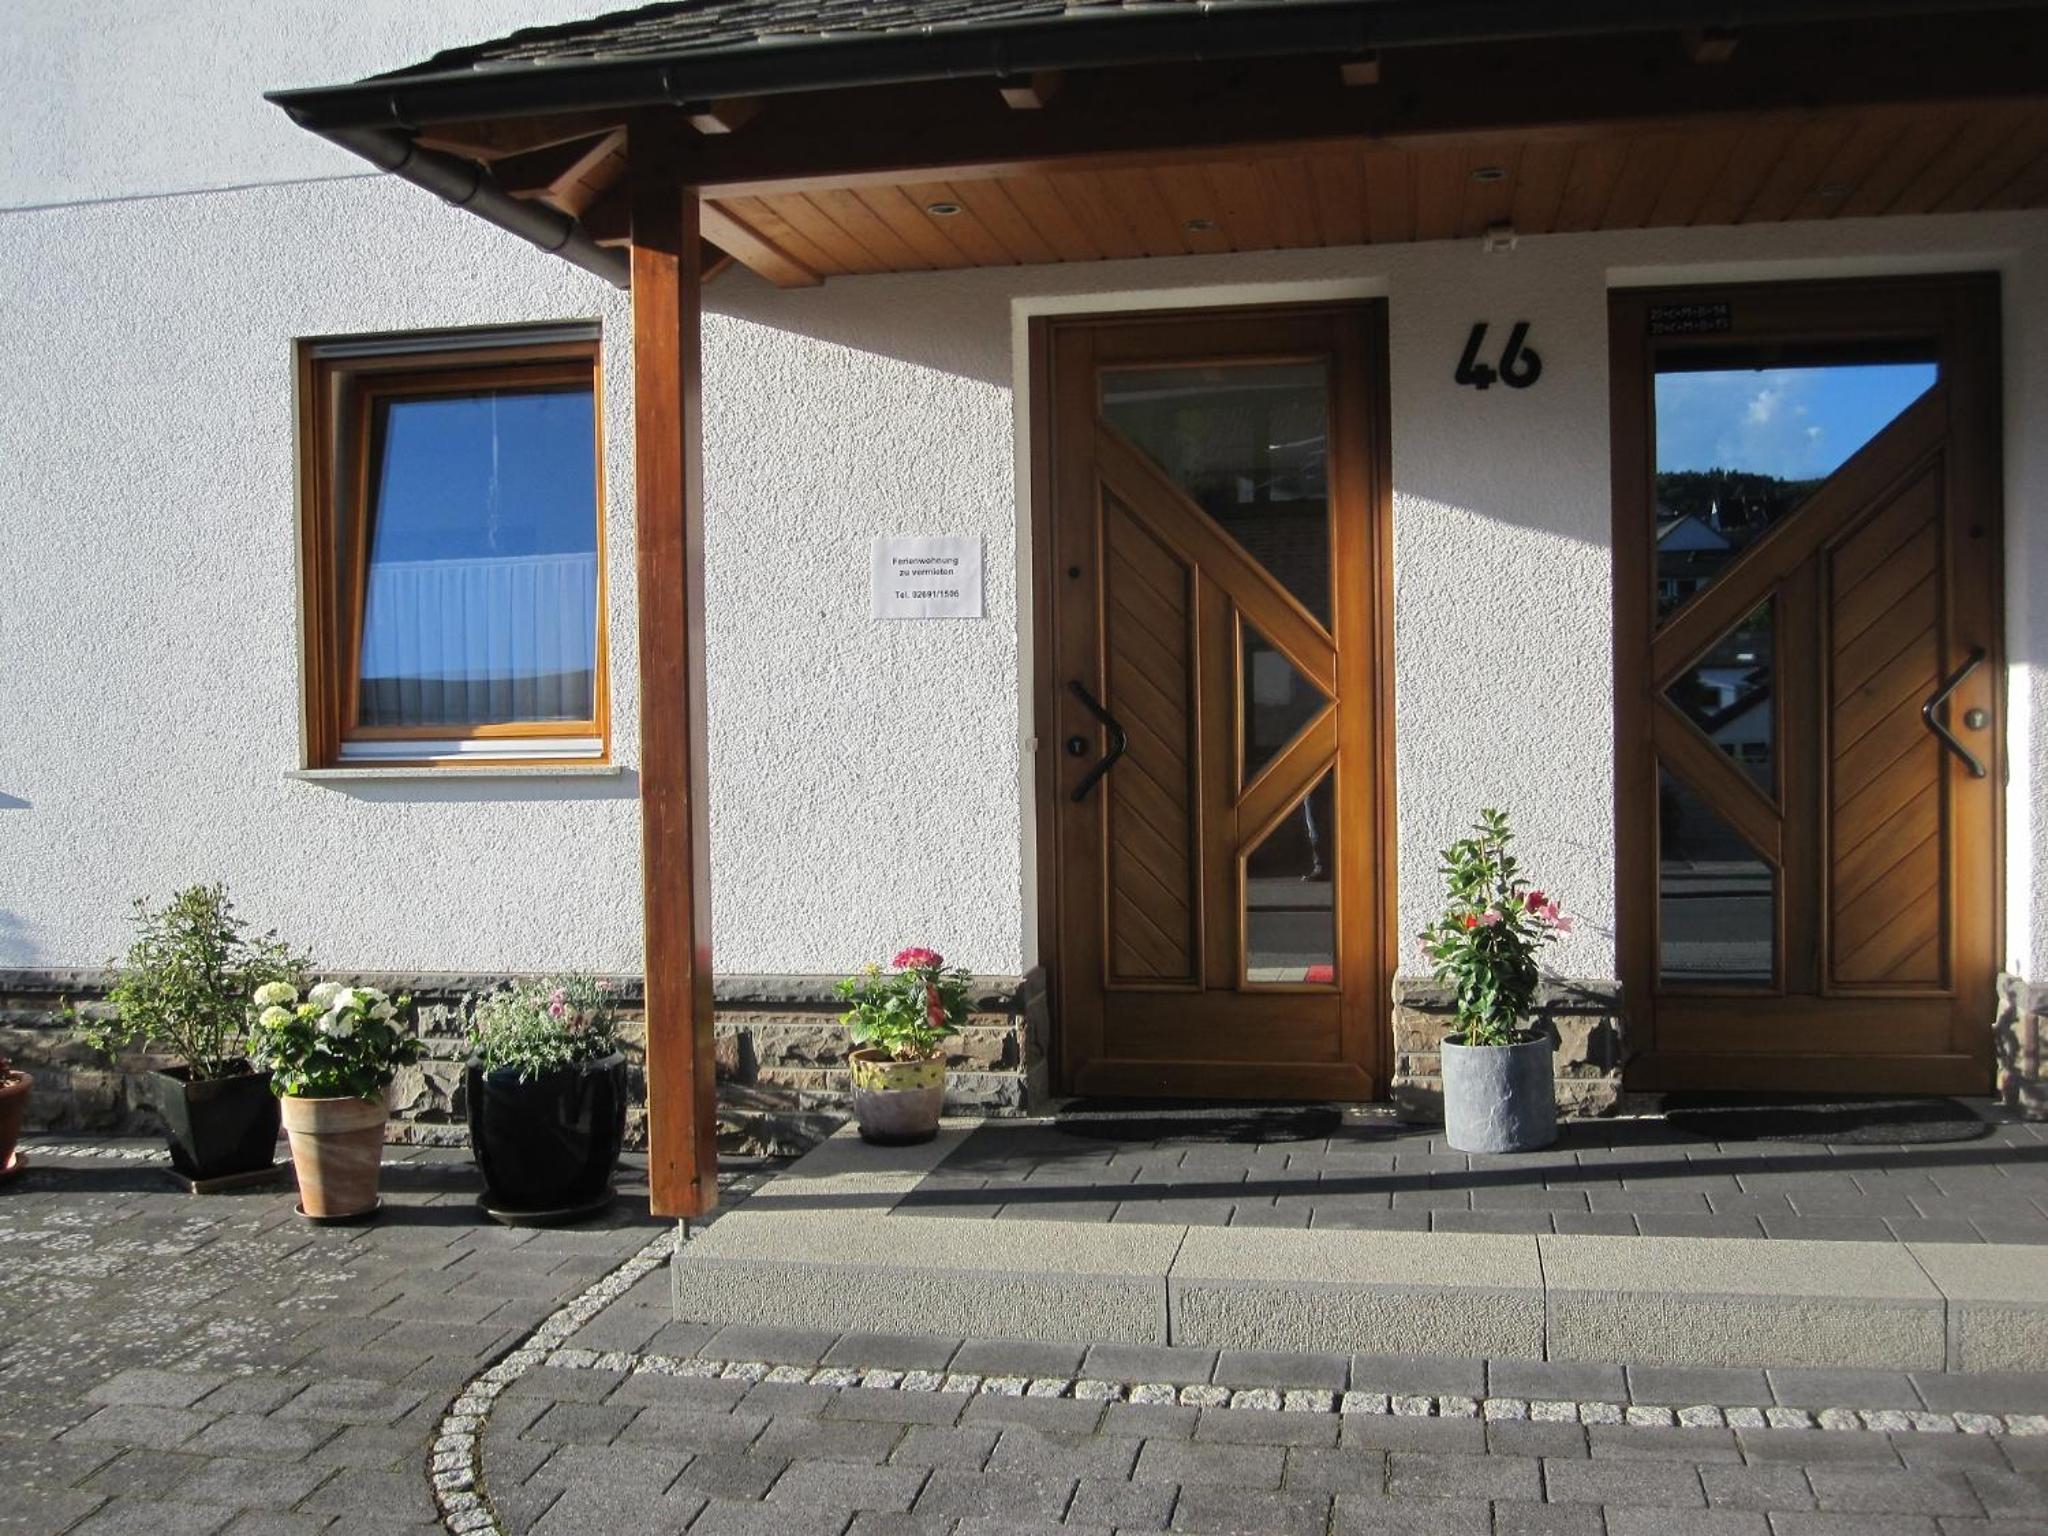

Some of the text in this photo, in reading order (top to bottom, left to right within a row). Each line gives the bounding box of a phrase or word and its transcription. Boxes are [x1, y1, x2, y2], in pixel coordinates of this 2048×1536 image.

[1455, 322, 1542, 390] 46
[892, 557, 959, 567] Ferienwohnung
[899, 567, 954, 577] zu vermieten
